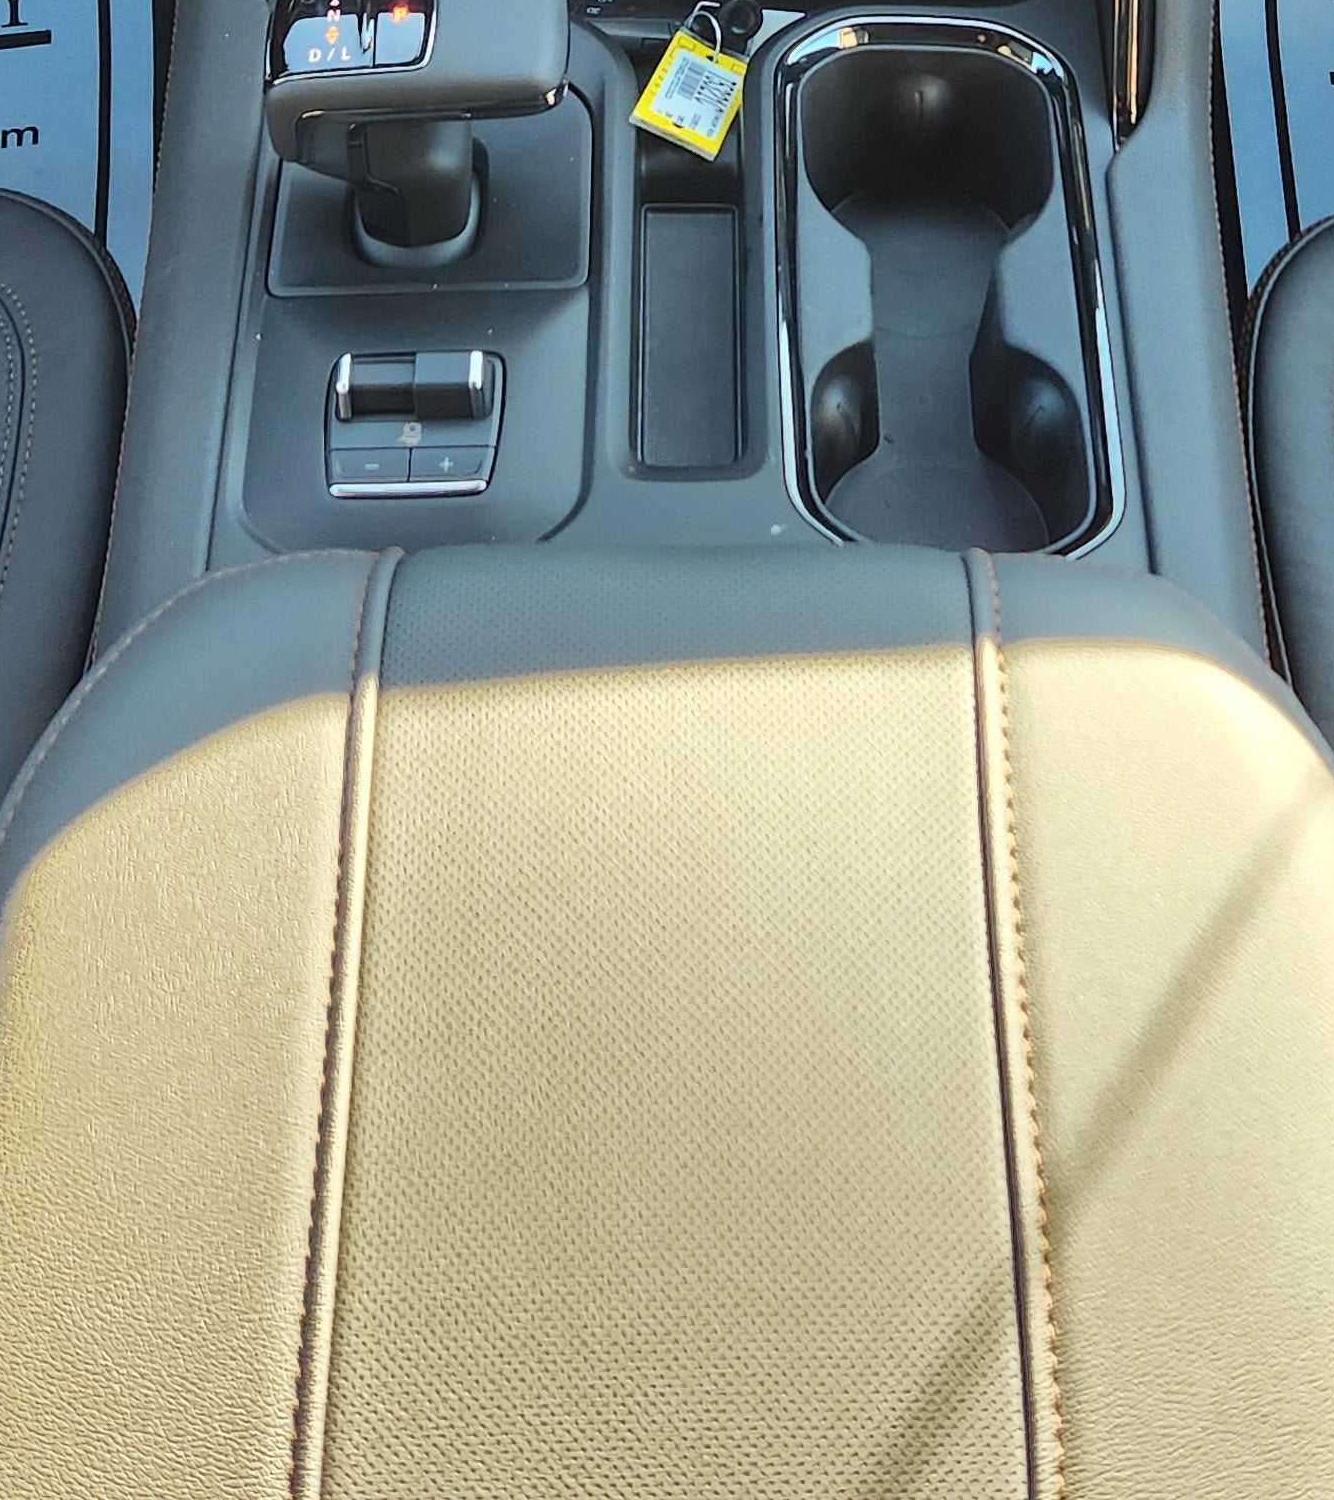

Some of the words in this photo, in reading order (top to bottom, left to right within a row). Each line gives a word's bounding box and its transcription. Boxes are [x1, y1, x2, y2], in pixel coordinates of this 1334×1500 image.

[327, 8, 342, 22] N
[392, 4, 409, 24] P
[308, 49, 322, 62] D
